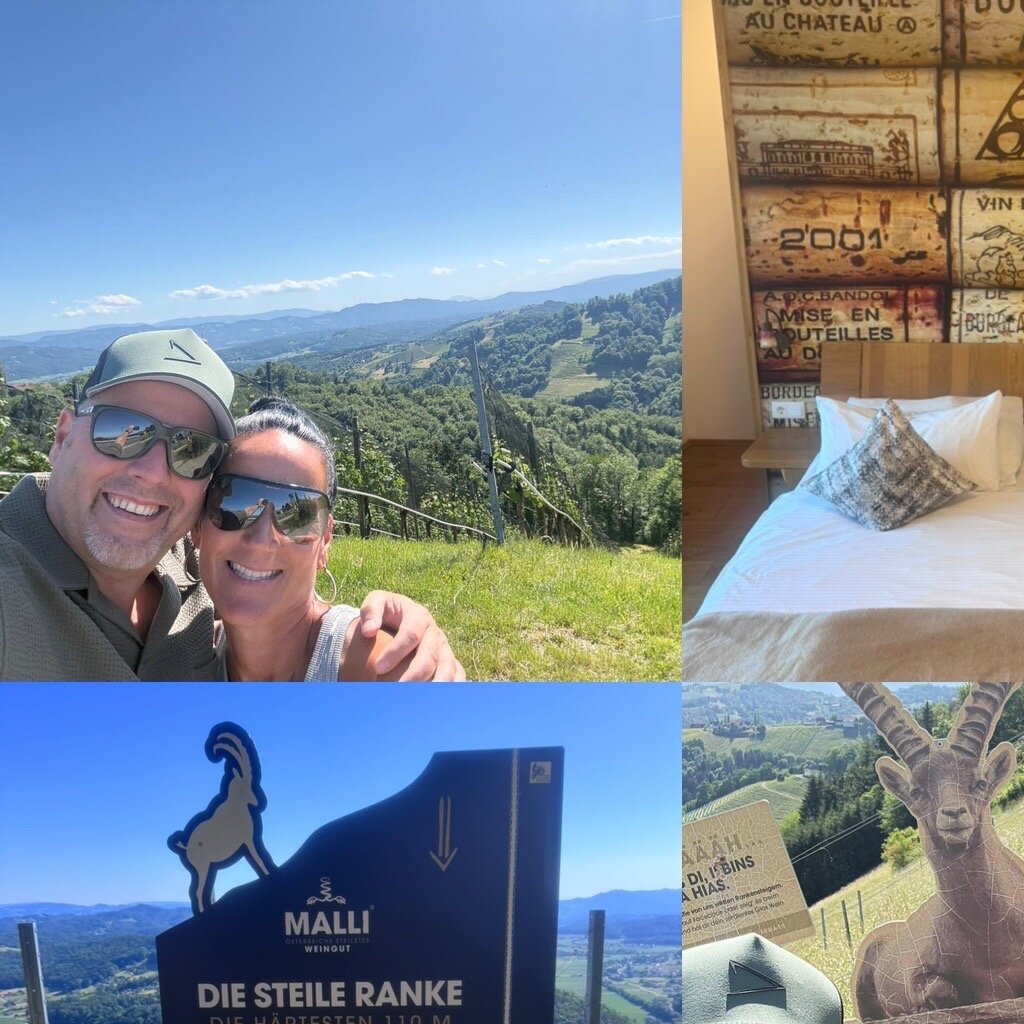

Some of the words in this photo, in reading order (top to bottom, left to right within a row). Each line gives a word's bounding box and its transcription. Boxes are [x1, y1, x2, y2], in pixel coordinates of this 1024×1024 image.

[745, 12, 775, 30] AU
[783, 12, 883, 33] CHATEAU
[977, 196, 1013, 211] VIN
[780, 226, 883, 251] 2001
[779, 308, 833, 322] MISE
[851, 308, 880, 322] EN
[721, 854, 756, 877] BINS
[692, 878, 731, 900] HIAS.
[284, 910, 370, 936] MALLI
[304, 944, 351, 953] WEINGUT
[198, 983, 246, 1008] DIE
[254, 981, 342, 1007] STEILE
[355, 980, 463, 1007] RANKE
